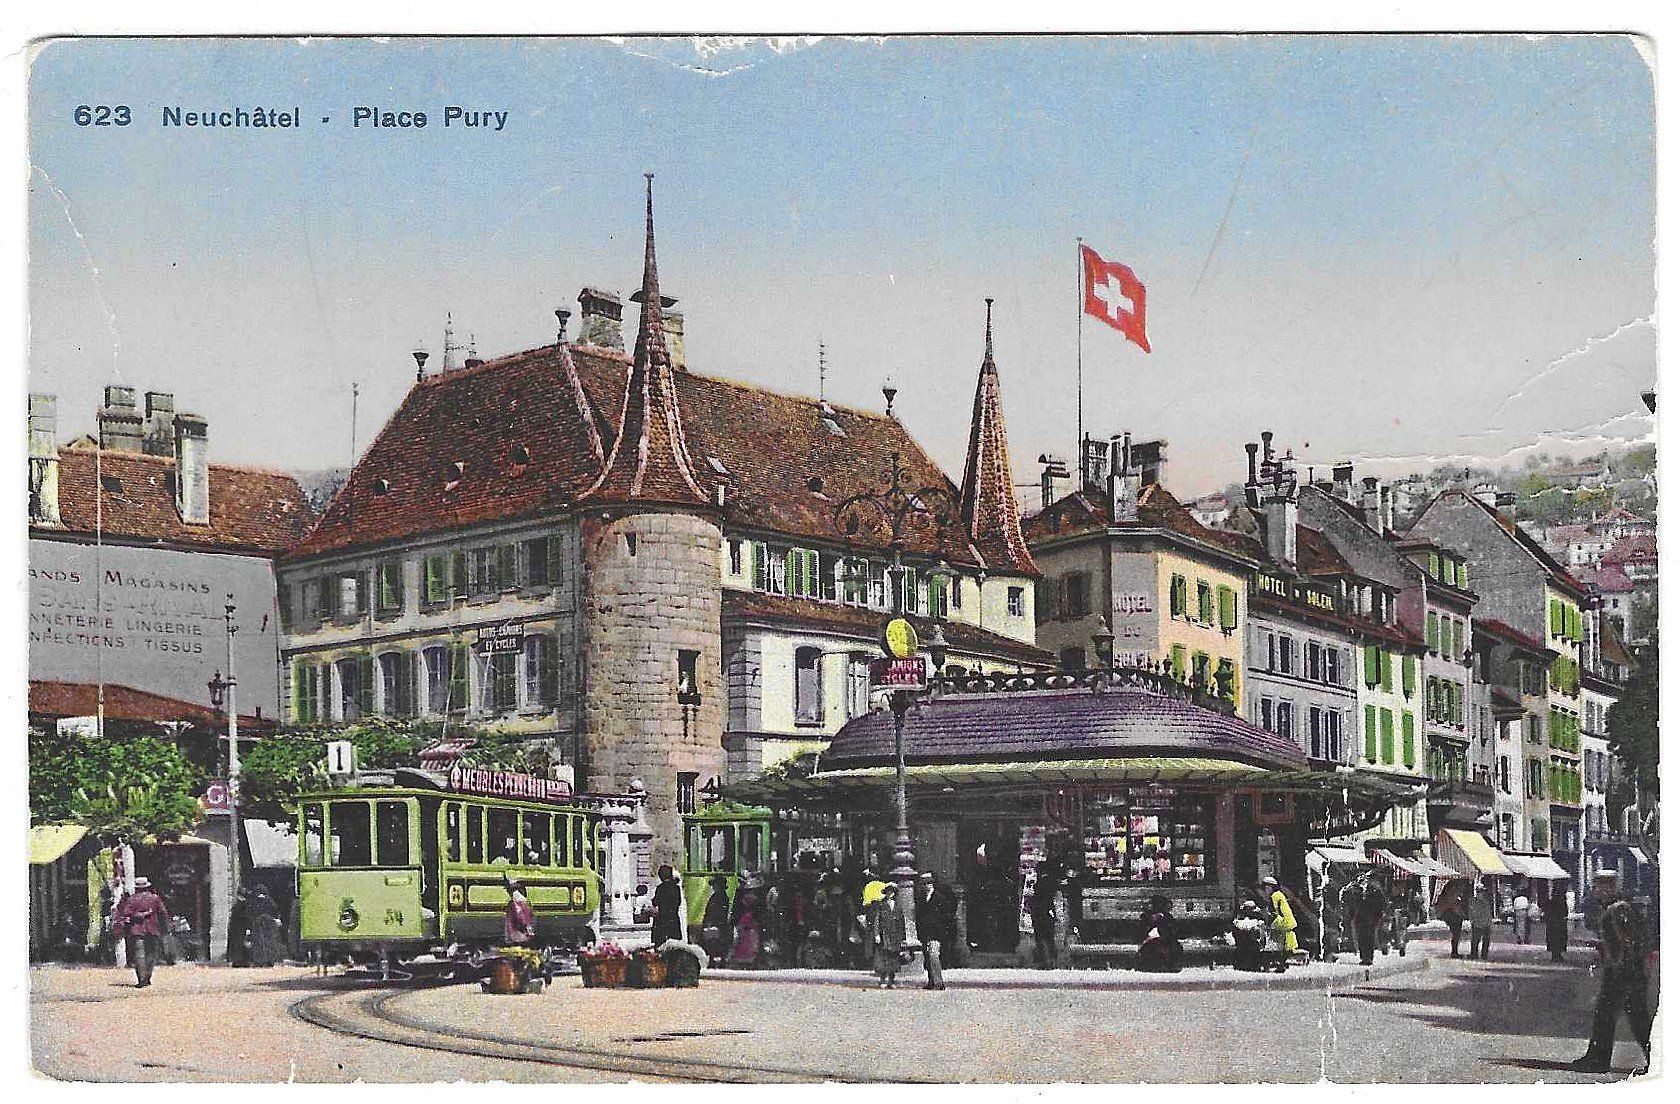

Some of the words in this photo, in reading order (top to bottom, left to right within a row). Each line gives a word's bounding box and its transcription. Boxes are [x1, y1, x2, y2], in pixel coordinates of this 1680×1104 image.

[126, 618, 202, 636] LINGERIE
[143, 637, 202, 654] TISSUS
[336, 745, 343, 772] 1
